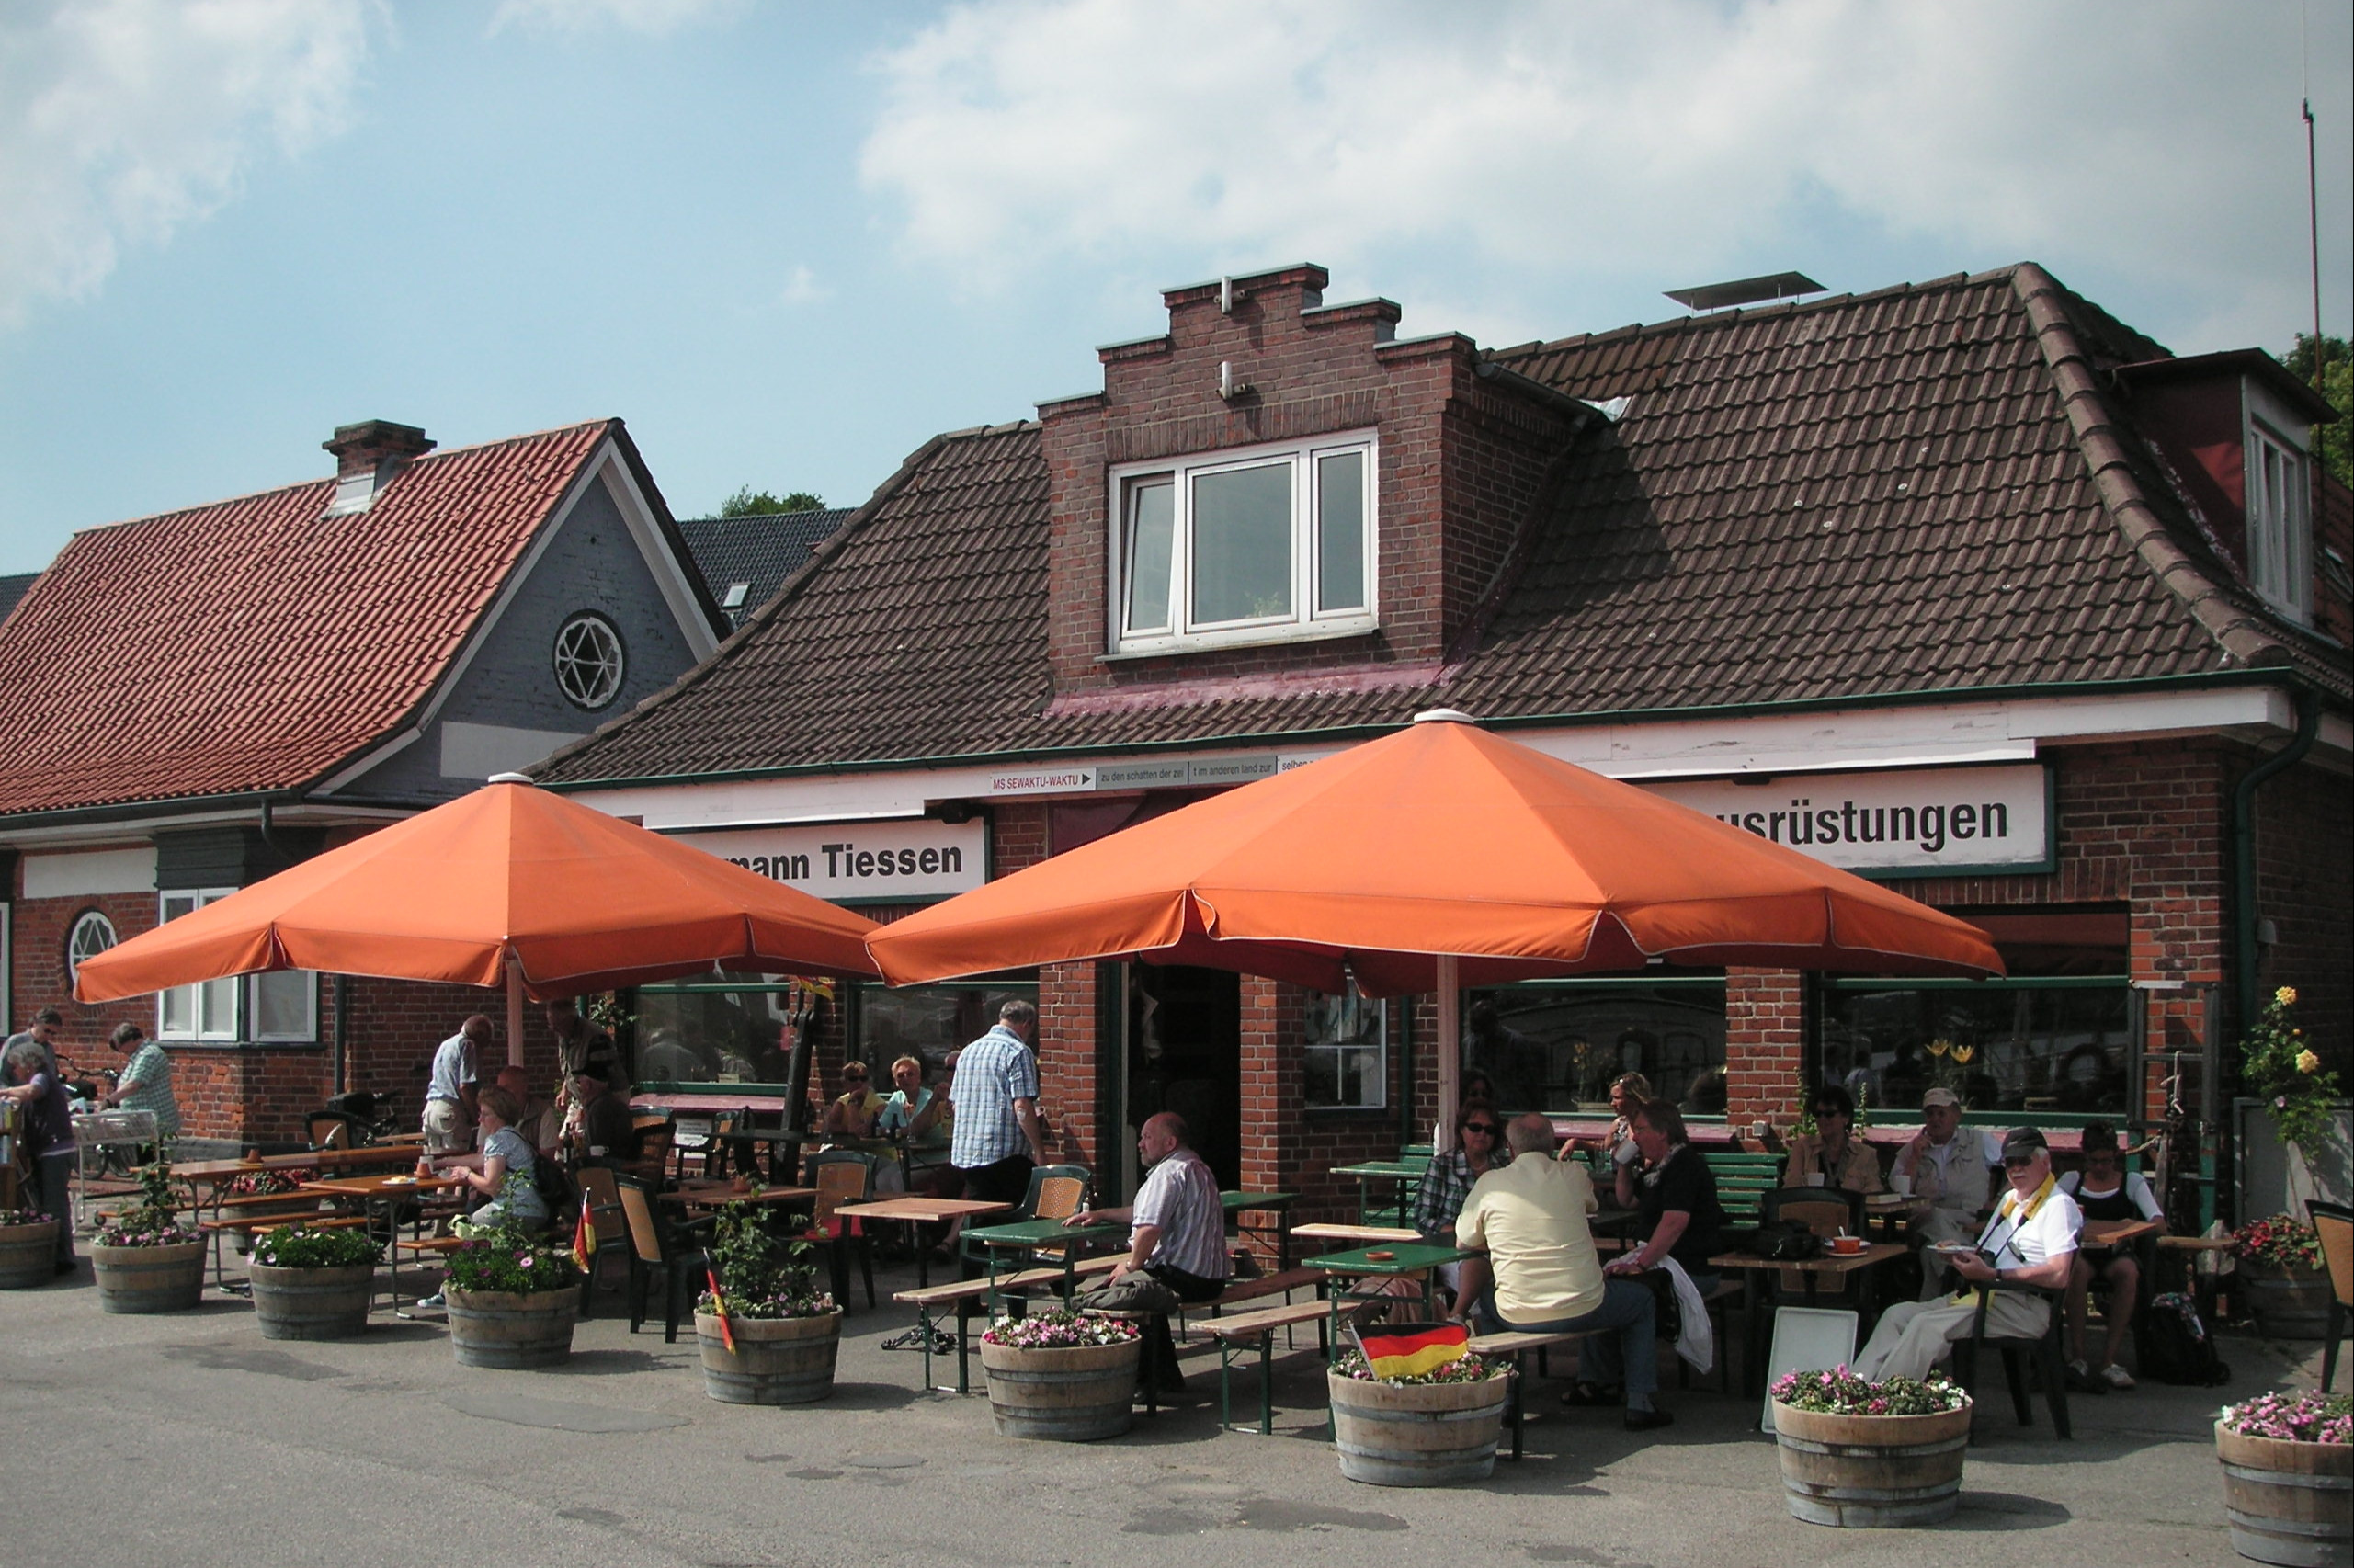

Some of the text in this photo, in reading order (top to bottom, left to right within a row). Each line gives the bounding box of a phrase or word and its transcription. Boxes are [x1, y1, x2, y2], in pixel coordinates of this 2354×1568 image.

[1101, 774, 1111, 782] zu
[1112, 772, 1125, 781] den
[1126, 769, 1157, 780] schatten
[1159, 768, 1172, 778] der
[1198, 766, 1208, 777] im
[1209, 765, 1240, 776] anderen
[1241, 764, 1258, 774] land
[1259, 765, 1272, 773] zur
[993, 775, 1079, 790] MS SEWAKTU-WAKTU
[1716, 798, 2007, 853] srüstungen
[821, 844, 962, 878] Tiessen
